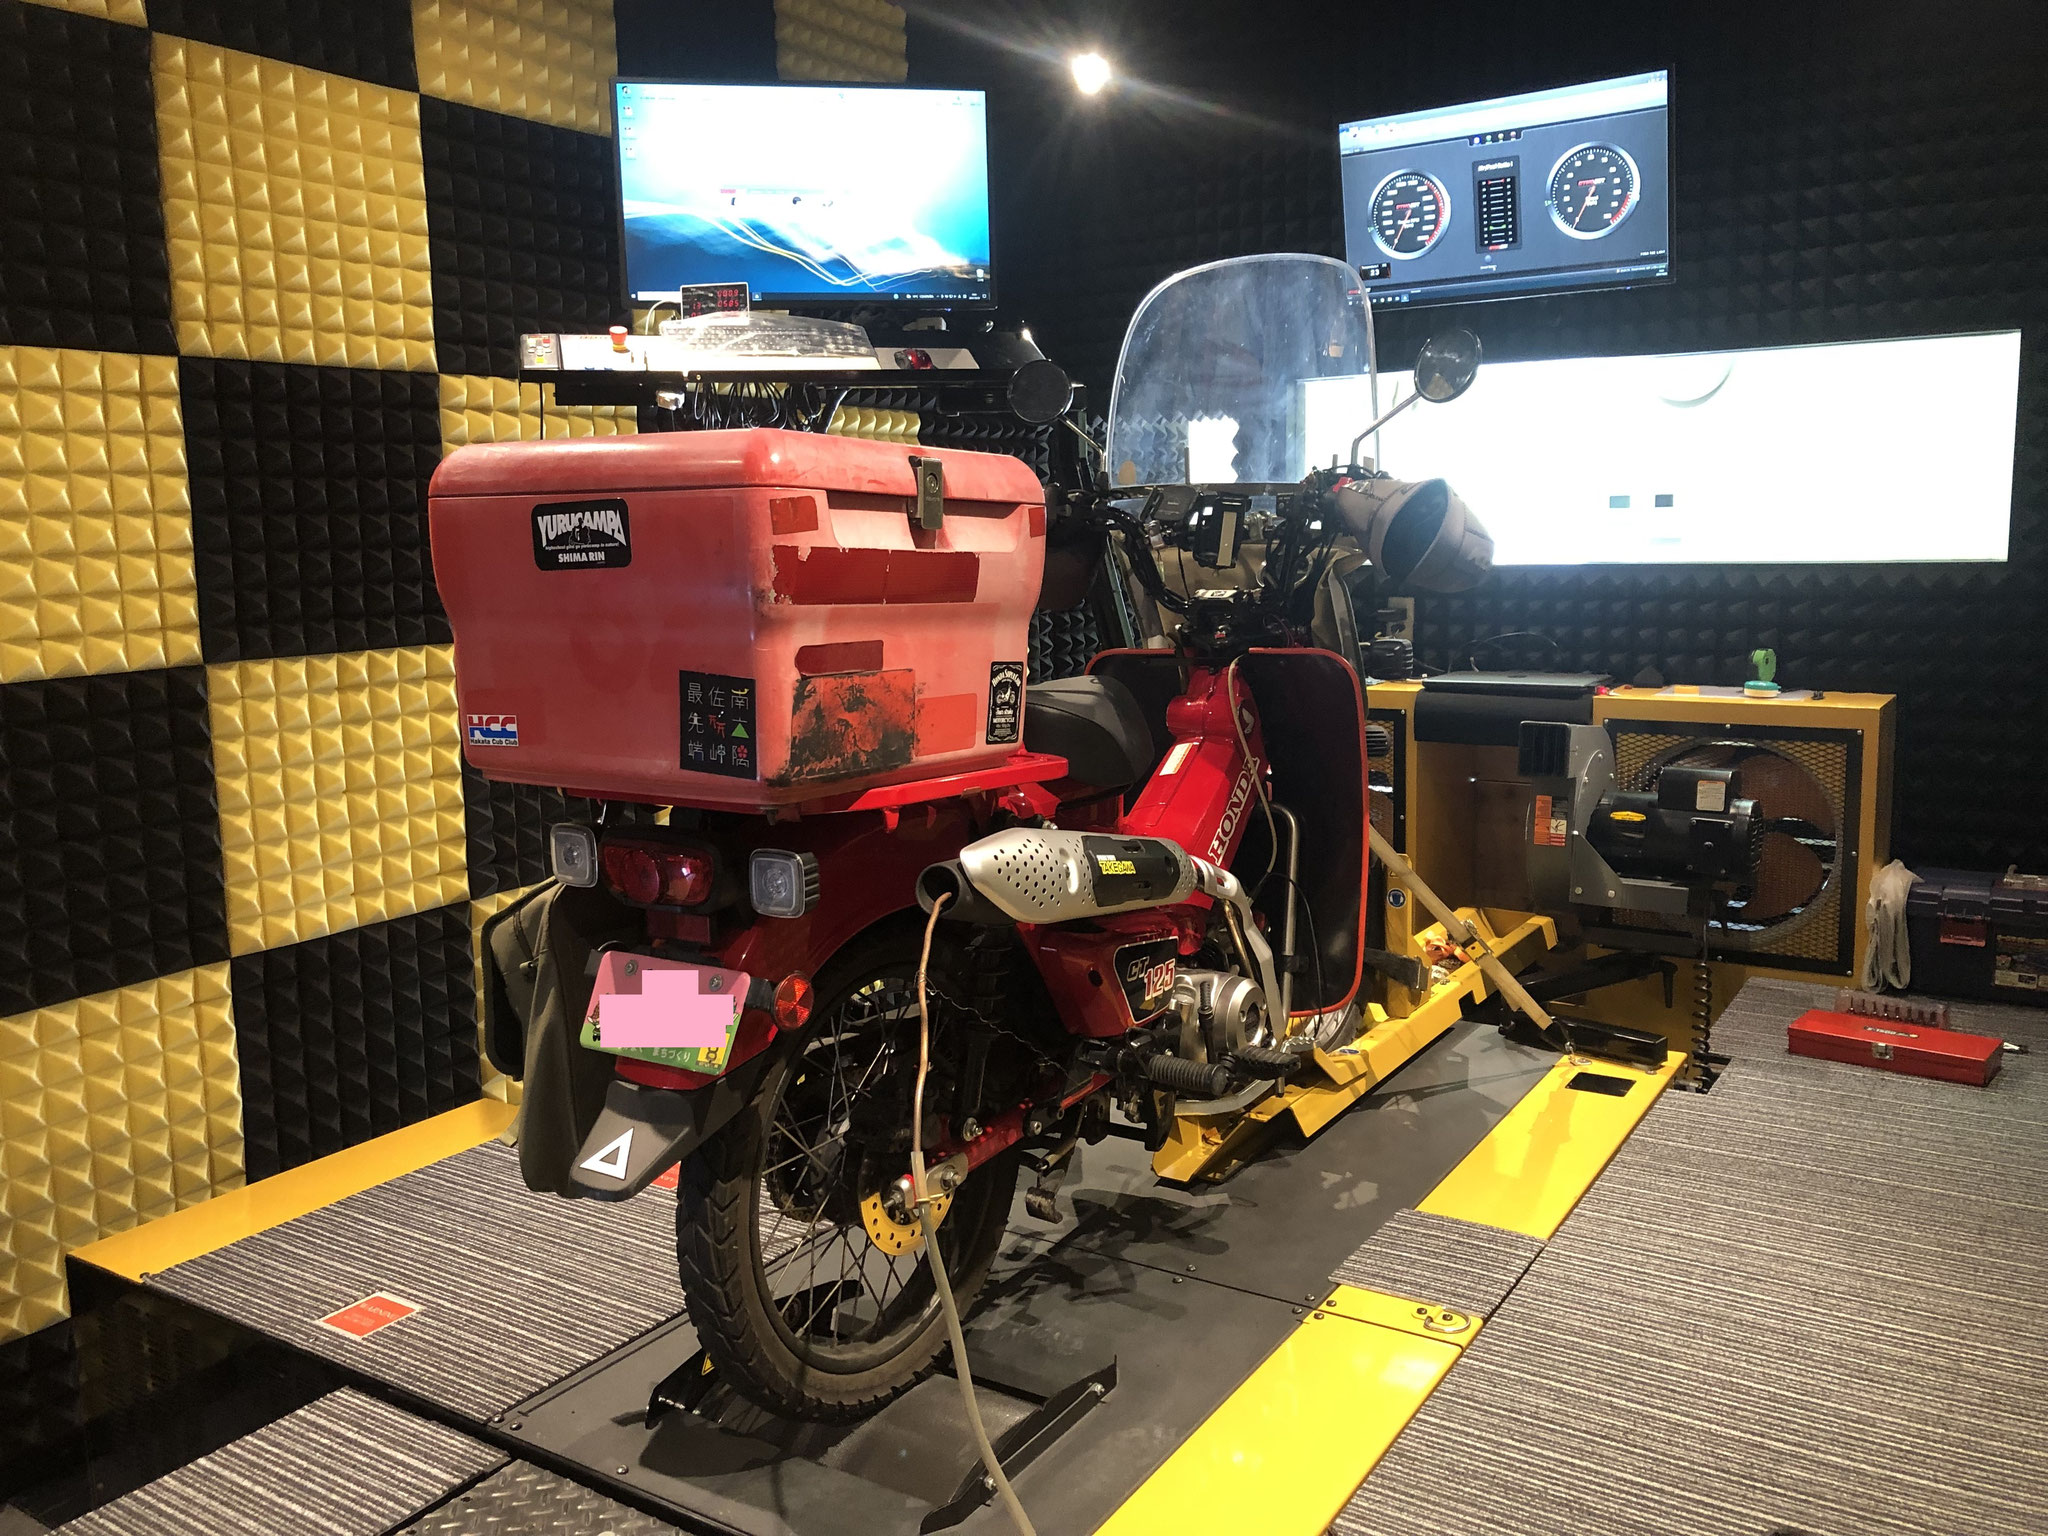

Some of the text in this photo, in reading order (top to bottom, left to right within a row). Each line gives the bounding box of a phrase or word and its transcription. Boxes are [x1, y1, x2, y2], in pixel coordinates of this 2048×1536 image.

[558, 551, 605, 563] SHIMA RIN
[468, 715, 517, 739] HCC
[1208, 756, 1260, 867] HONDA
[1098, 860, 1137, 875] TAKEGAWA
[1126, 955, 1176, 1001] CT 125
